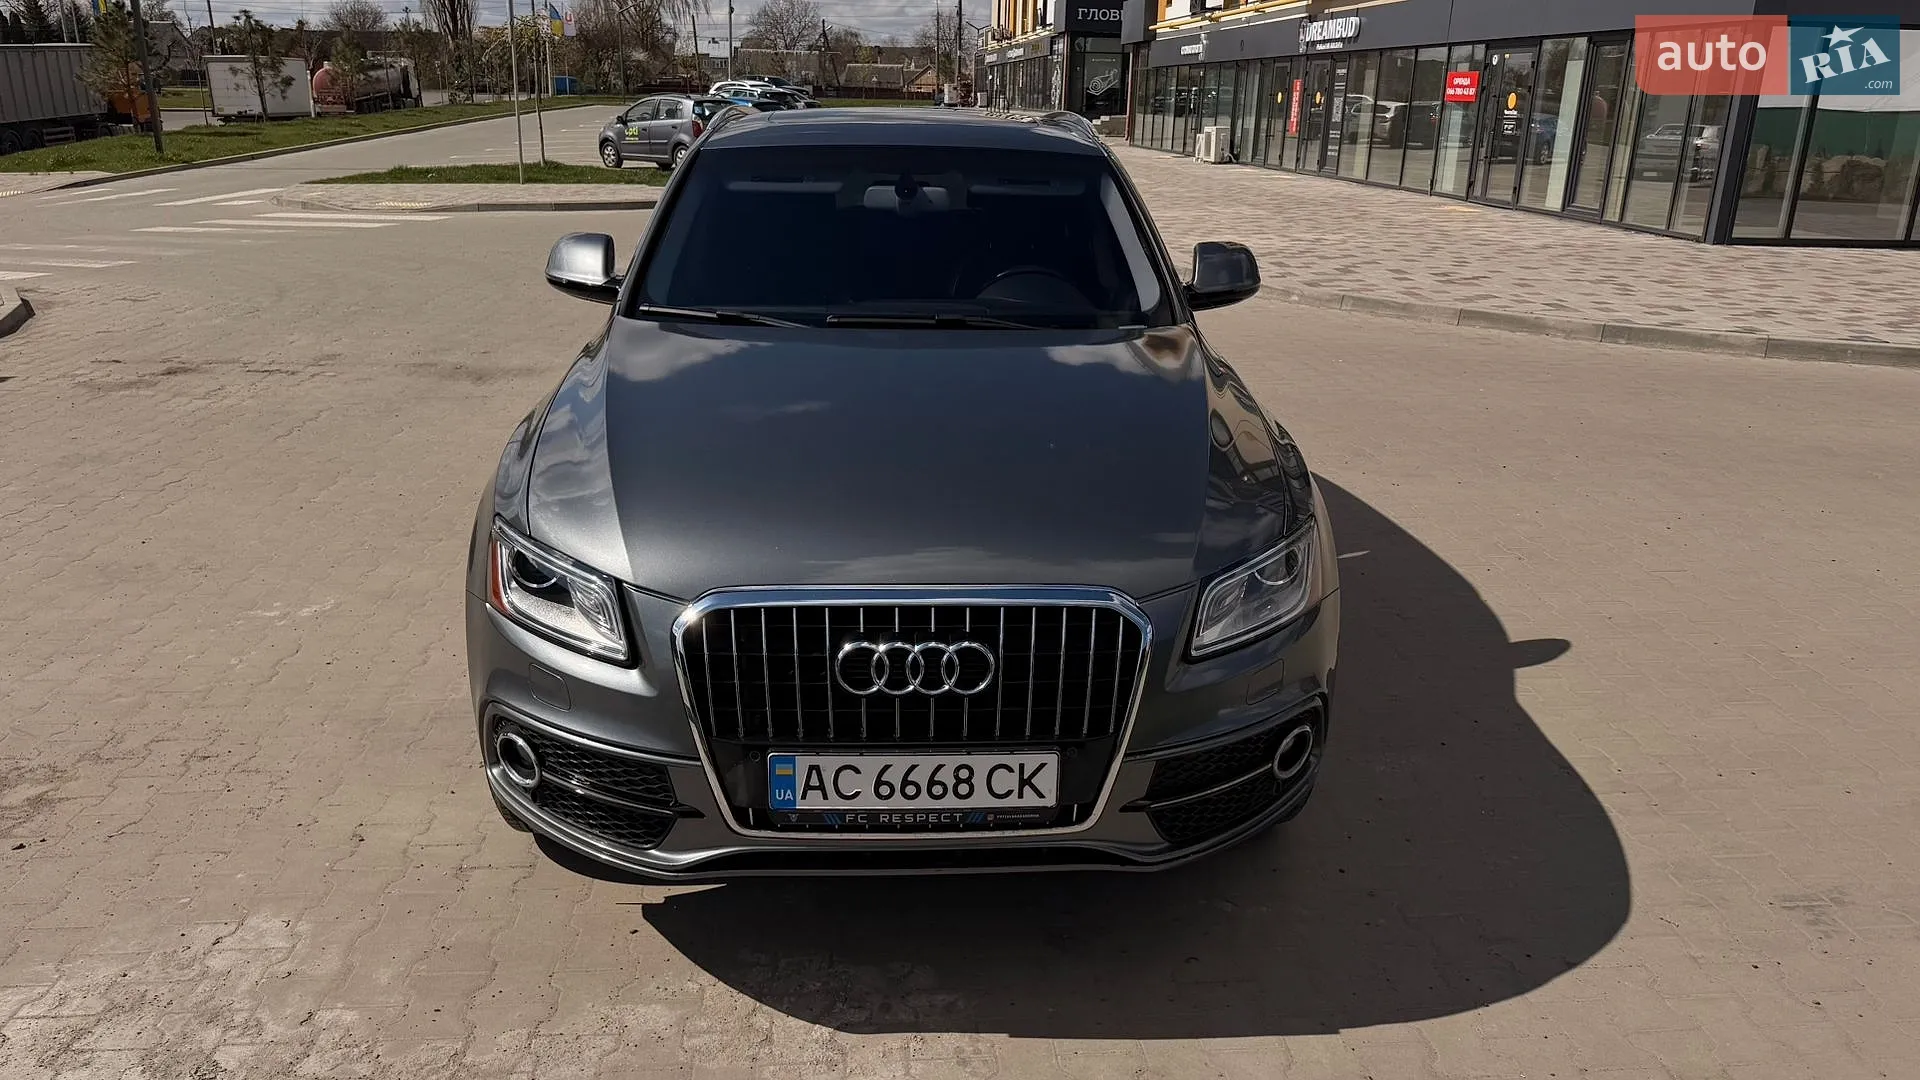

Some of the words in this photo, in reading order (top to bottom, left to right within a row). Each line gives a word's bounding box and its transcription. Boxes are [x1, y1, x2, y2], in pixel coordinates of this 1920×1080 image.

[1305, 17, 1360, 41] DREAMBUD
[800, 763, 862, 801] AC
[873, 763, 975, 801] 6668
[986, 761, 1049, 800] CK
[775, 789, 794, 801] UA
[845, 813, 868, 824] FC
[879, 812, 963, 824] RESPECT
